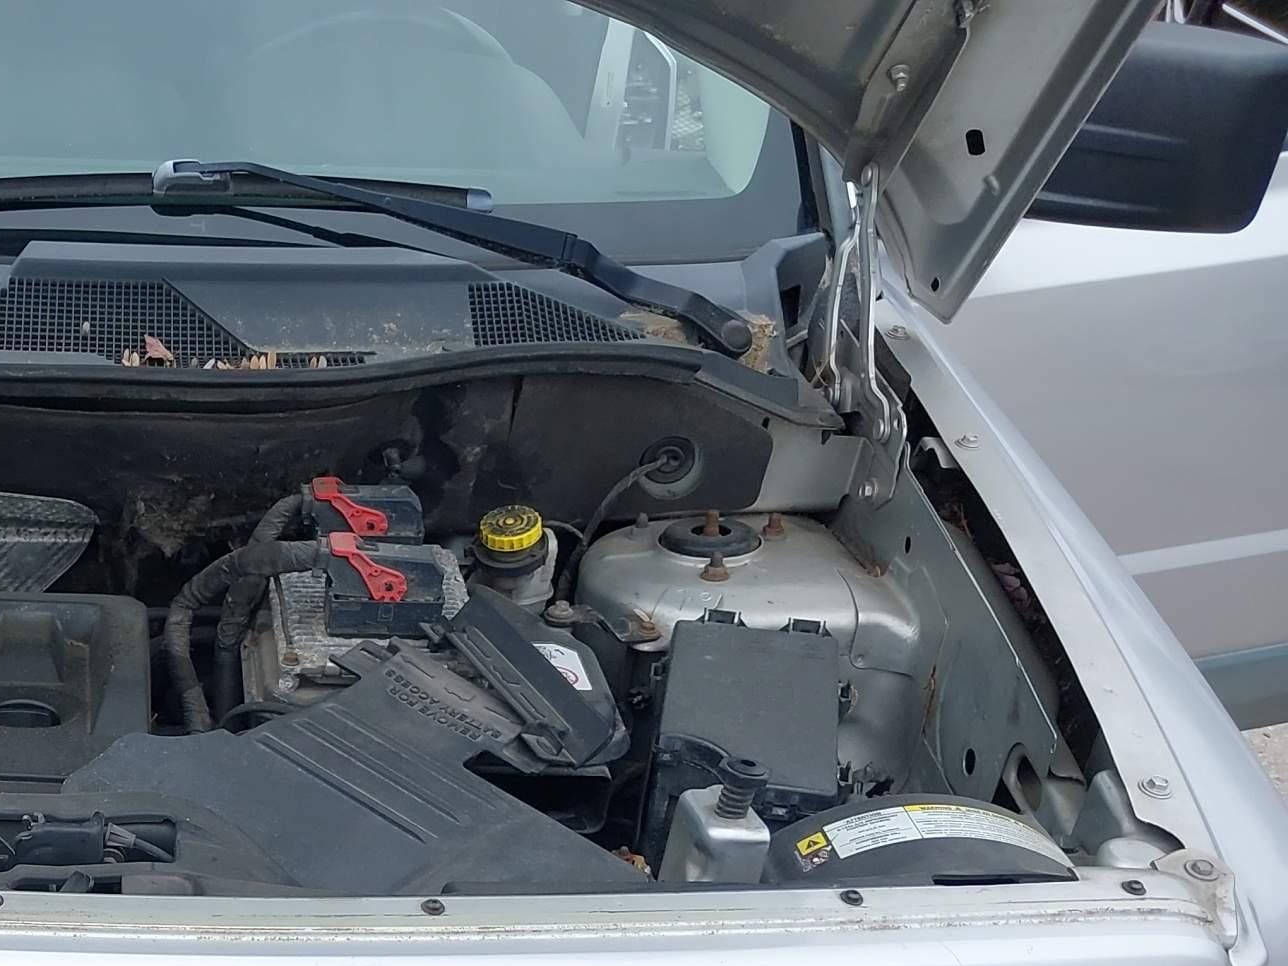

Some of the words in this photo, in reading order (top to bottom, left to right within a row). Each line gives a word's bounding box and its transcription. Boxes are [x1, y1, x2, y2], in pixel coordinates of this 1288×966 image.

[384, 668, 441, 705] ACCESS
[388, 685, 418, 708] FOR
[418, 705, 482, 741] REMOVE
[439, 704, 503, 740] BATTERY
